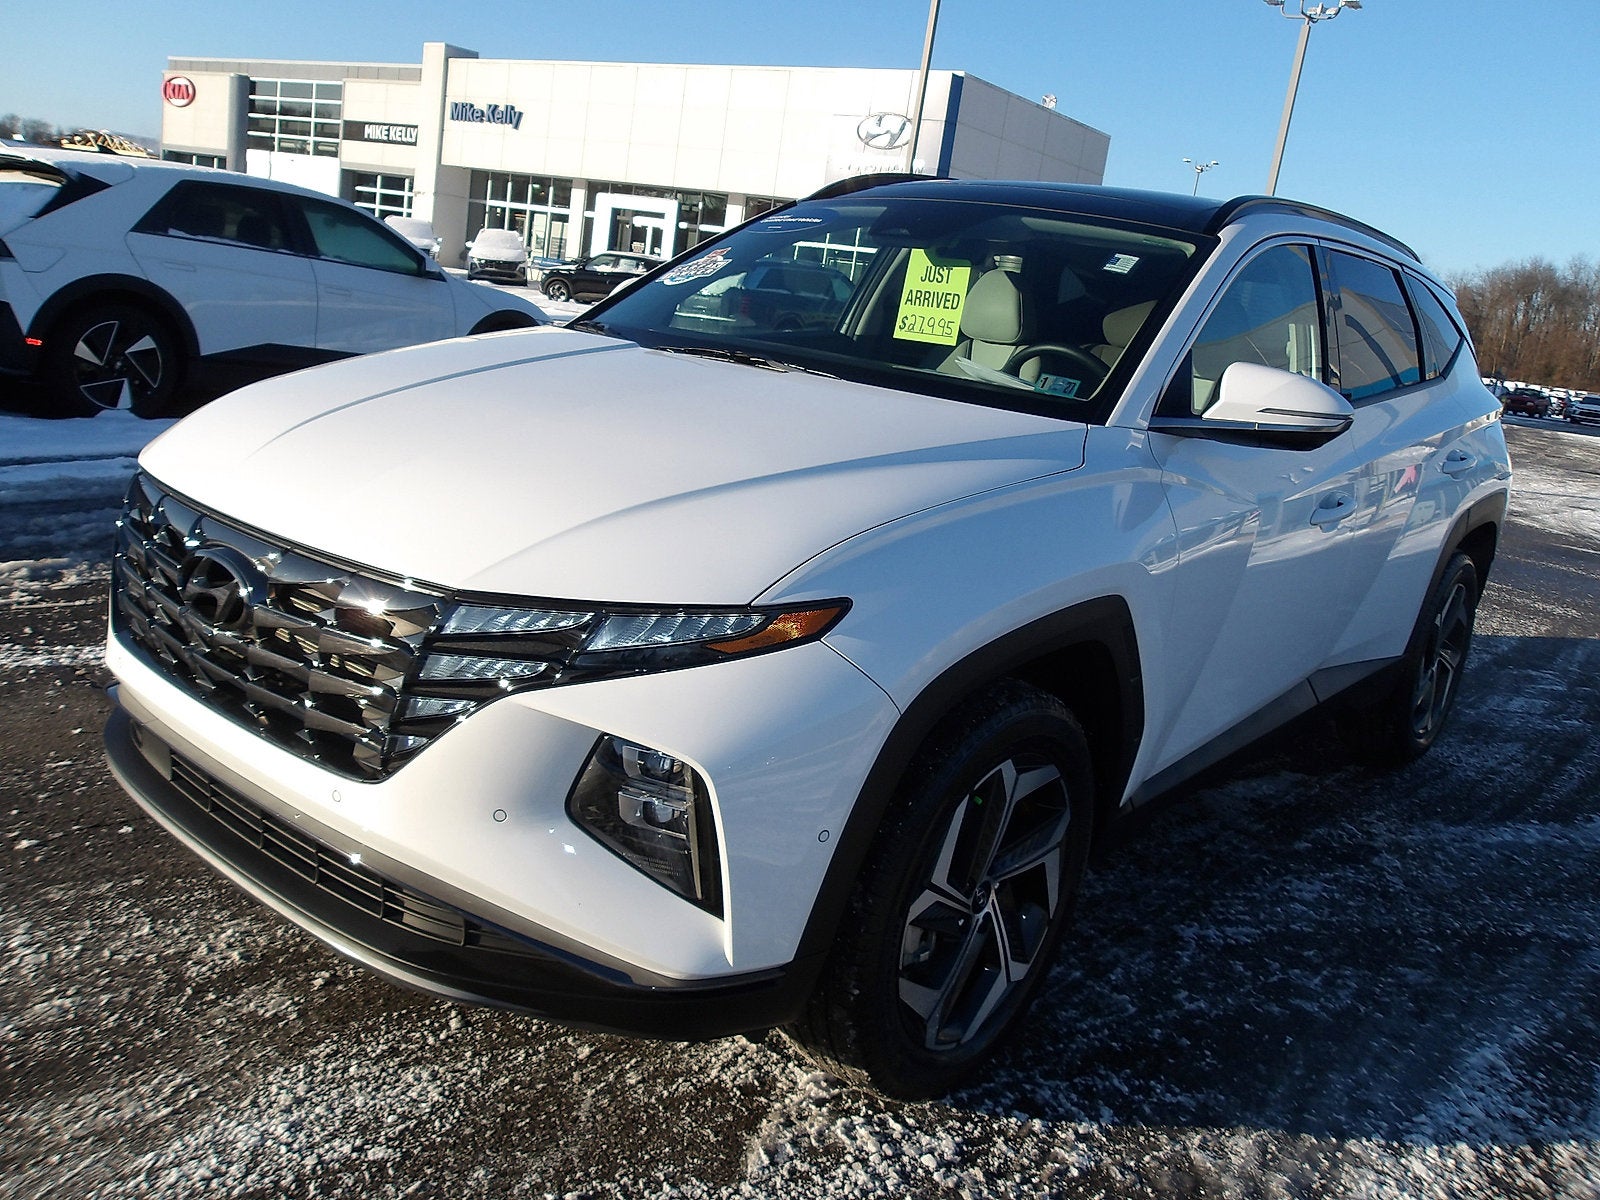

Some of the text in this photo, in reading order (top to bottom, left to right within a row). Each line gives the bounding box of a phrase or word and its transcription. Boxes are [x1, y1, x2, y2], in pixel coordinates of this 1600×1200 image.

[450, 101, 523, 130] Mike Kelly
[364, 124, 418, 143] MIKE KELLY
[920, 265, 953, 284] JUST
[904, 289, 961, 310] ARRIVED
[899, 314, 955, 336] $27,995
